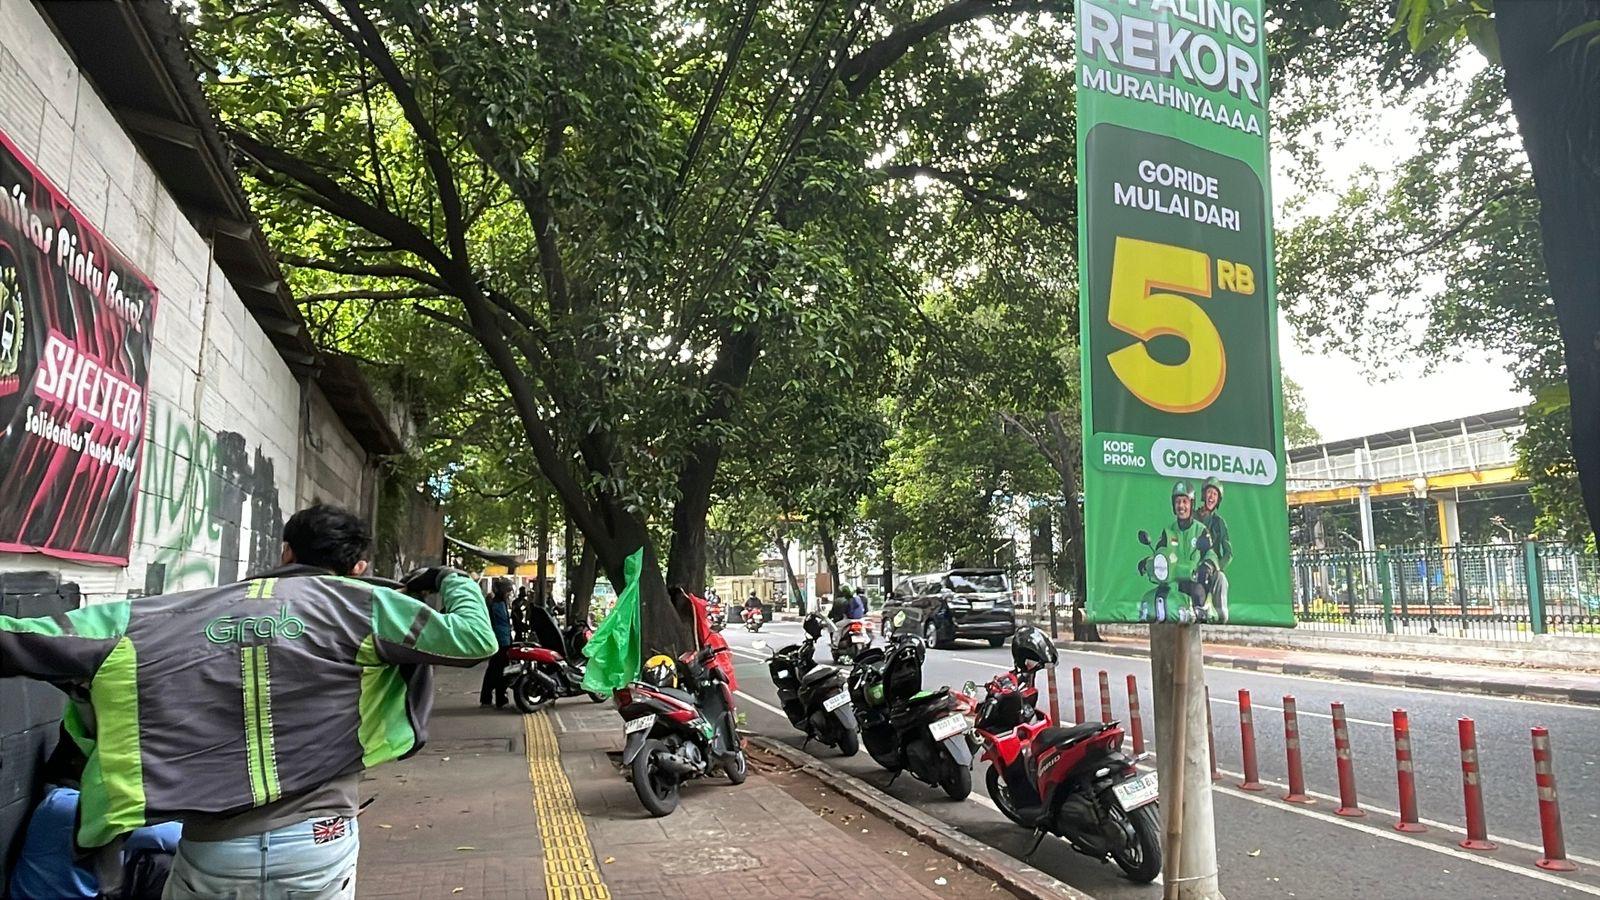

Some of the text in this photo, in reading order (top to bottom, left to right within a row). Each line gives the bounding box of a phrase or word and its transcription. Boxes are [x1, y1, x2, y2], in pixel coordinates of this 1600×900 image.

[1127, 0, 1256, 43] LING
[1080, 2, 1261, 104] REKOR
[1082, 65, 1262, 137] MURAHNYAAAA
[1138, 160, 1218, 200] GORIDE
[1114, 183, 1240, 232] MULAI DARI
[57, 227, 102, 297] Pintu
[1107, 236, 1256, 413] 5 RB
[37, 335, 142, 436] SHELTER
[25, 406, 83, 452] Solidaritas
[1103, 440, 1268, 477] KODE GORIDEAJA
[1103, 453, 1146, 468] PROMO
[204, 605, 305, 644] Grab
